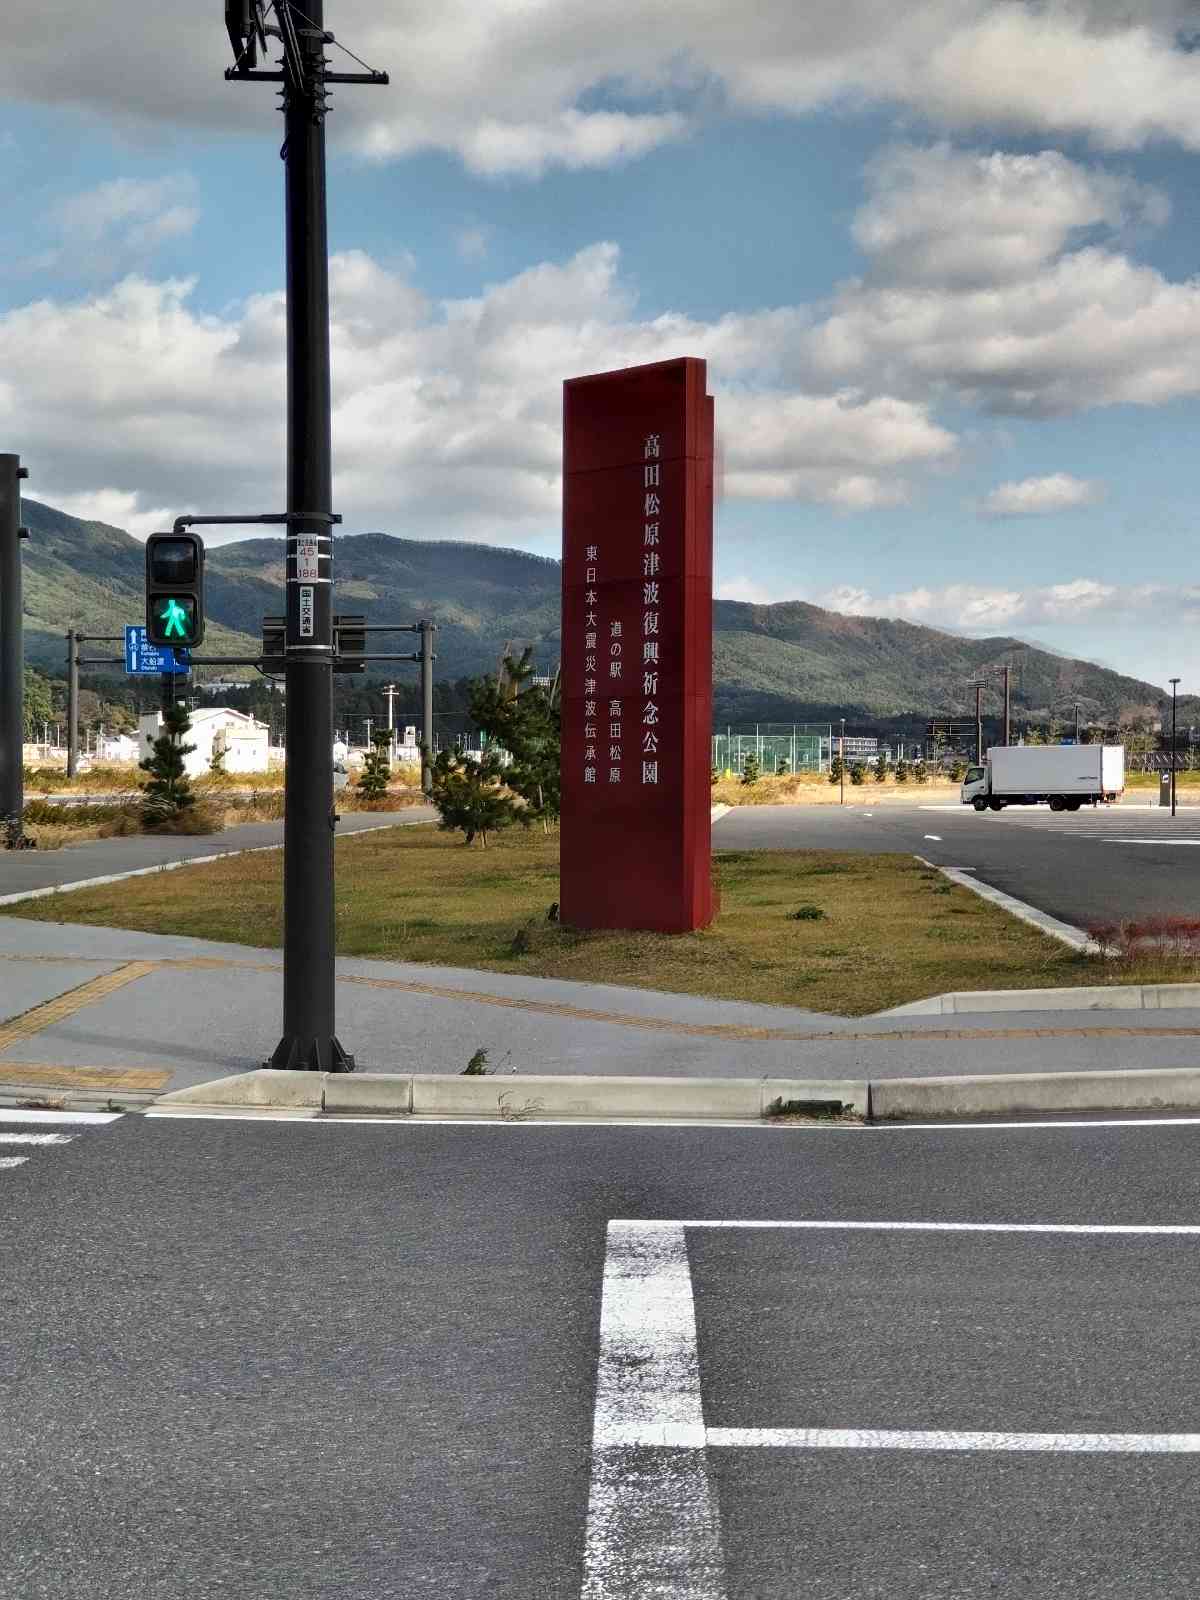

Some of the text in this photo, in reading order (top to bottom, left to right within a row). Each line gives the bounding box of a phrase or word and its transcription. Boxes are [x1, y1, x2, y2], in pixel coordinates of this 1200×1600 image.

[299, 546, 315, 557] 45
[301, 589, 312, 634] 国土交通省
[642, 434, 661, 784] 高田松原津波復興祈念公園
[584, 544, 598, 784] 東日本大震災津波伝承館
[609, 622, 623, 784] 道の駅 高田松原
